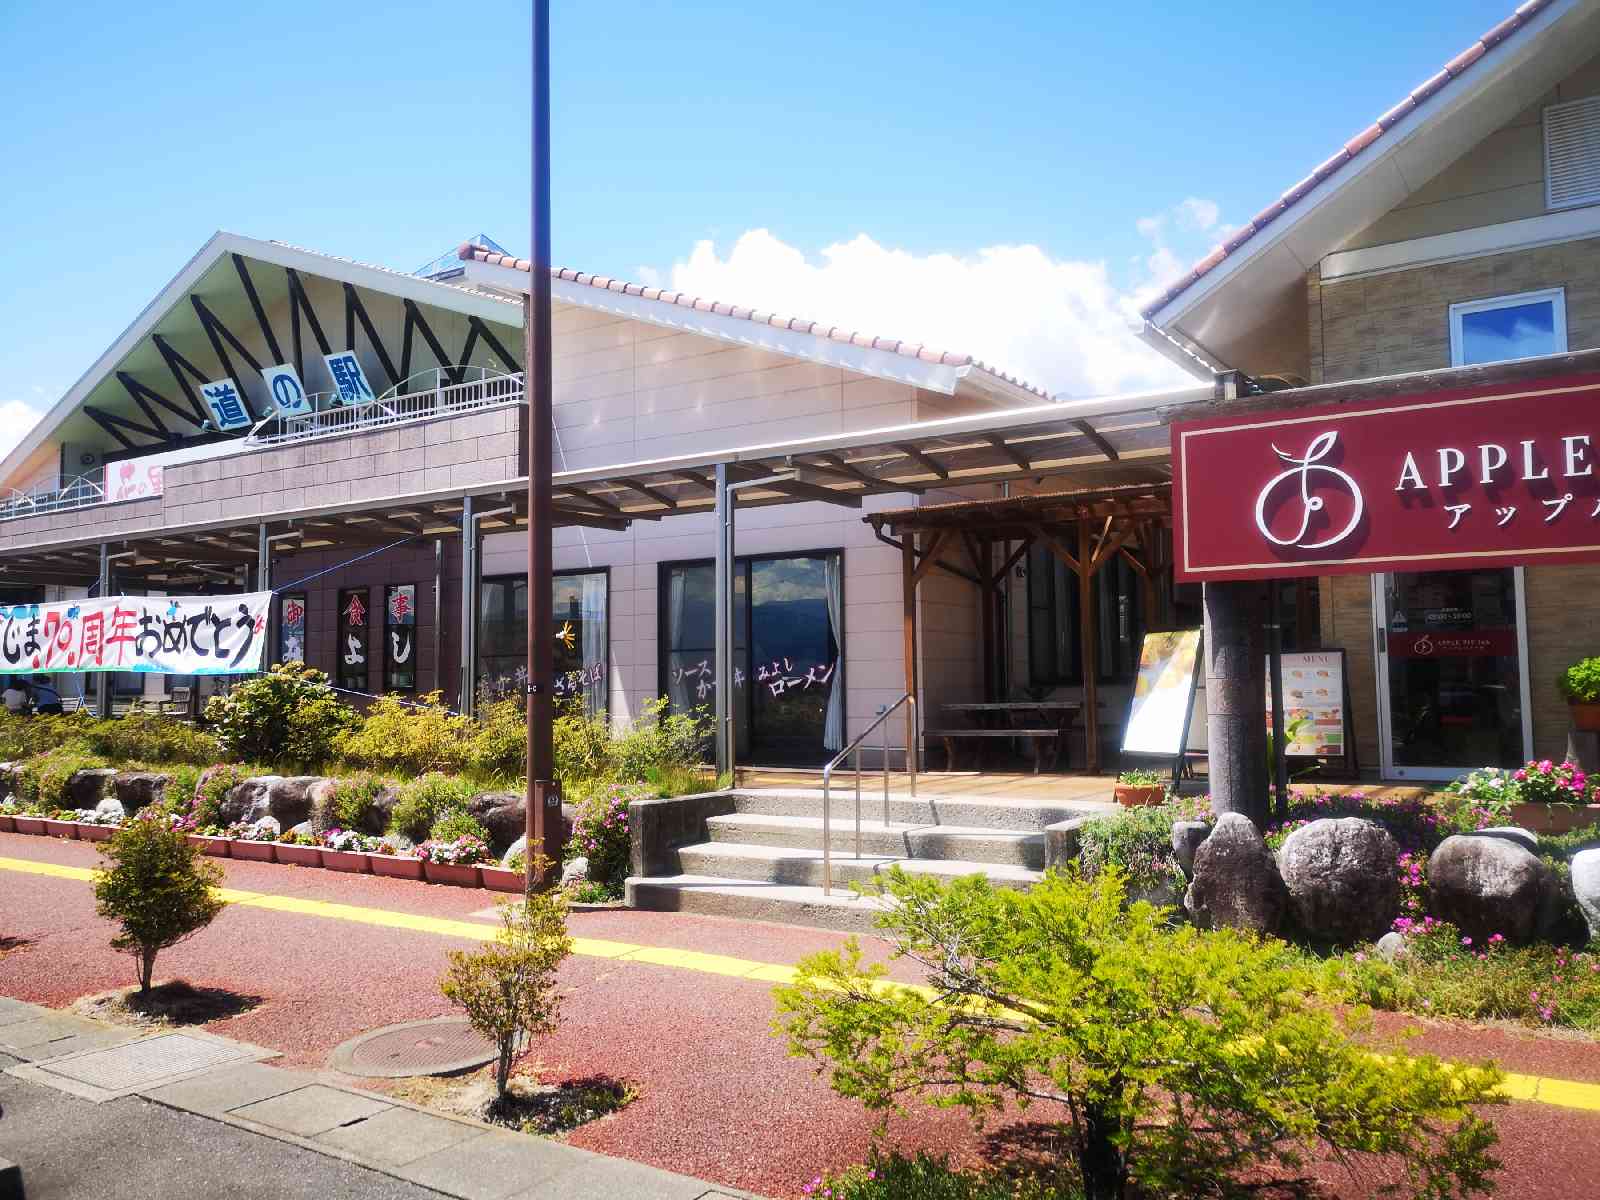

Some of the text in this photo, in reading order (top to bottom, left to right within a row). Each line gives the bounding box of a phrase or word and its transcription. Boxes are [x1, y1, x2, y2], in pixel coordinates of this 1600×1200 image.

[204, 356, 371, 427] 道の駅
[1395, 436, 1592, 490] APPLE
[768, 663, 834, 697] ローメン
